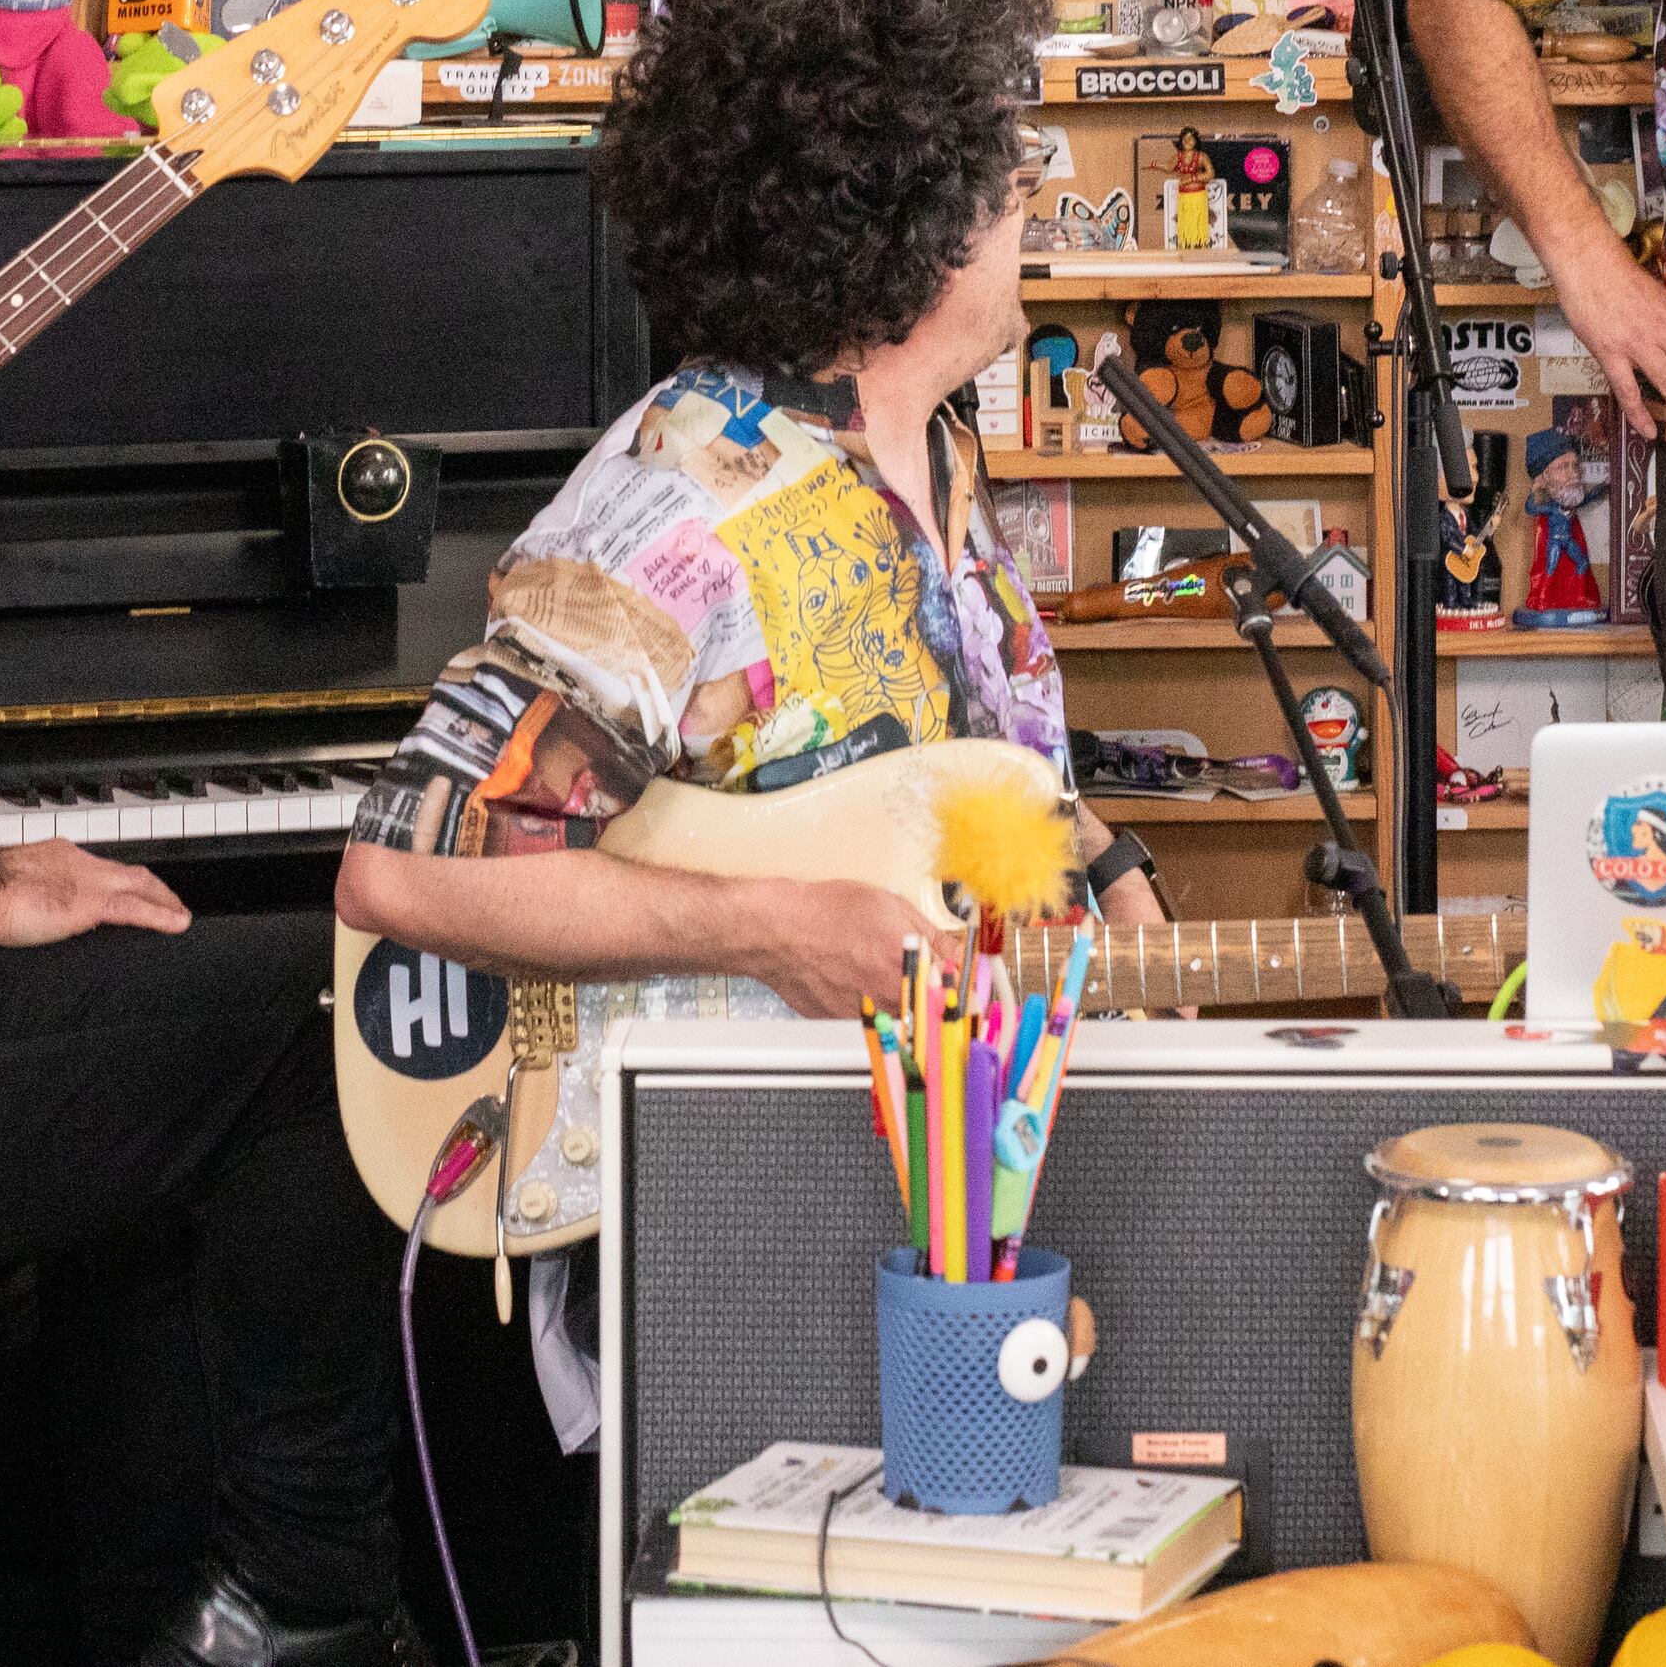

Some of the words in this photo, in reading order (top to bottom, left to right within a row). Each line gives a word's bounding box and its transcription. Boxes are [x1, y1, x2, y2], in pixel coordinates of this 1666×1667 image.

[117, 4, 173, 19] MINUTOS
[1080, 67, 1220, 95] BROCCOLI
[1599, 860, 1653, 877] COLO
[387, 950, 468, 1057] HI
